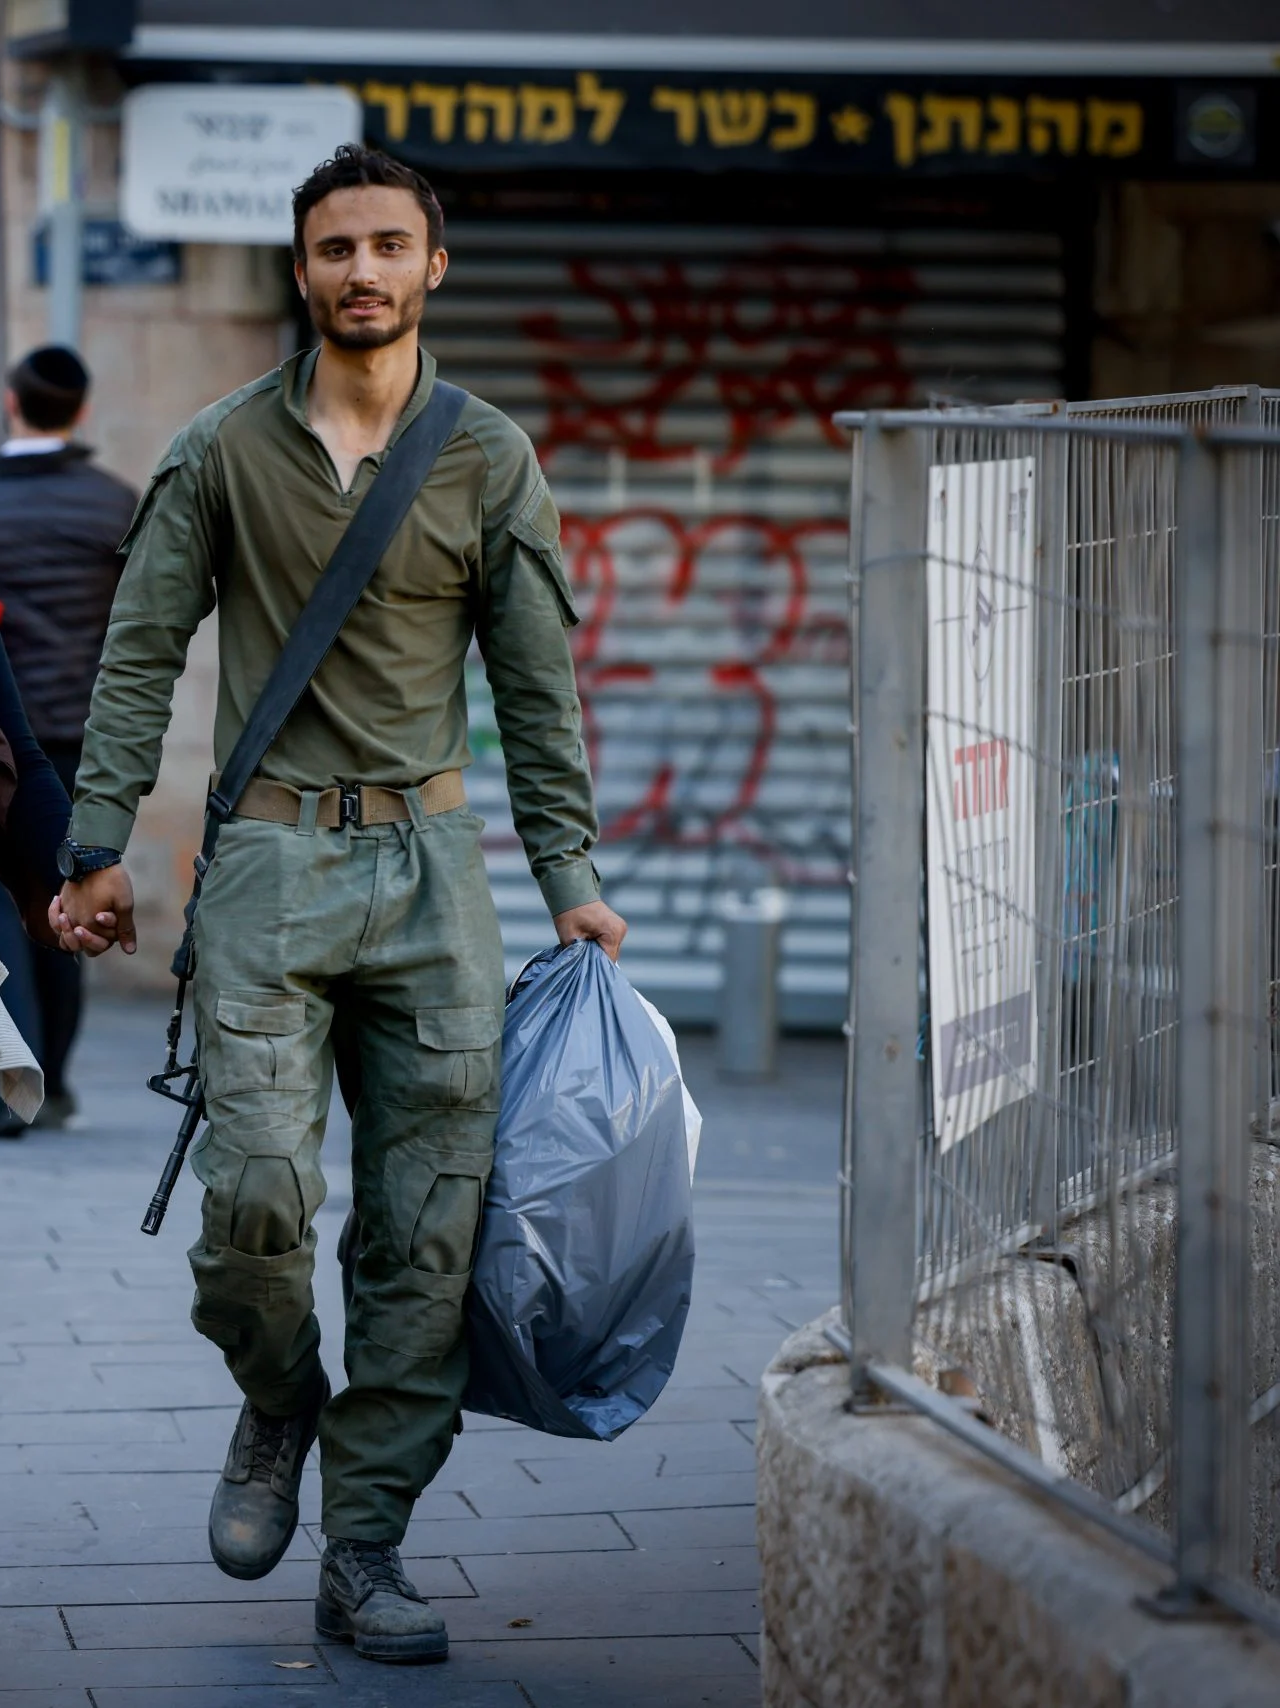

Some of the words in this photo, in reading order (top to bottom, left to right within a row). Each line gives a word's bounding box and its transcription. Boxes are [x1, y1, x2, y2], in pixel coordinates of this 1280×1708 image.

[342, 71, 624, 145] למהדר
[653, 87, 817, 149] כשר
[885, 92, 1143, 168] מהנתן
